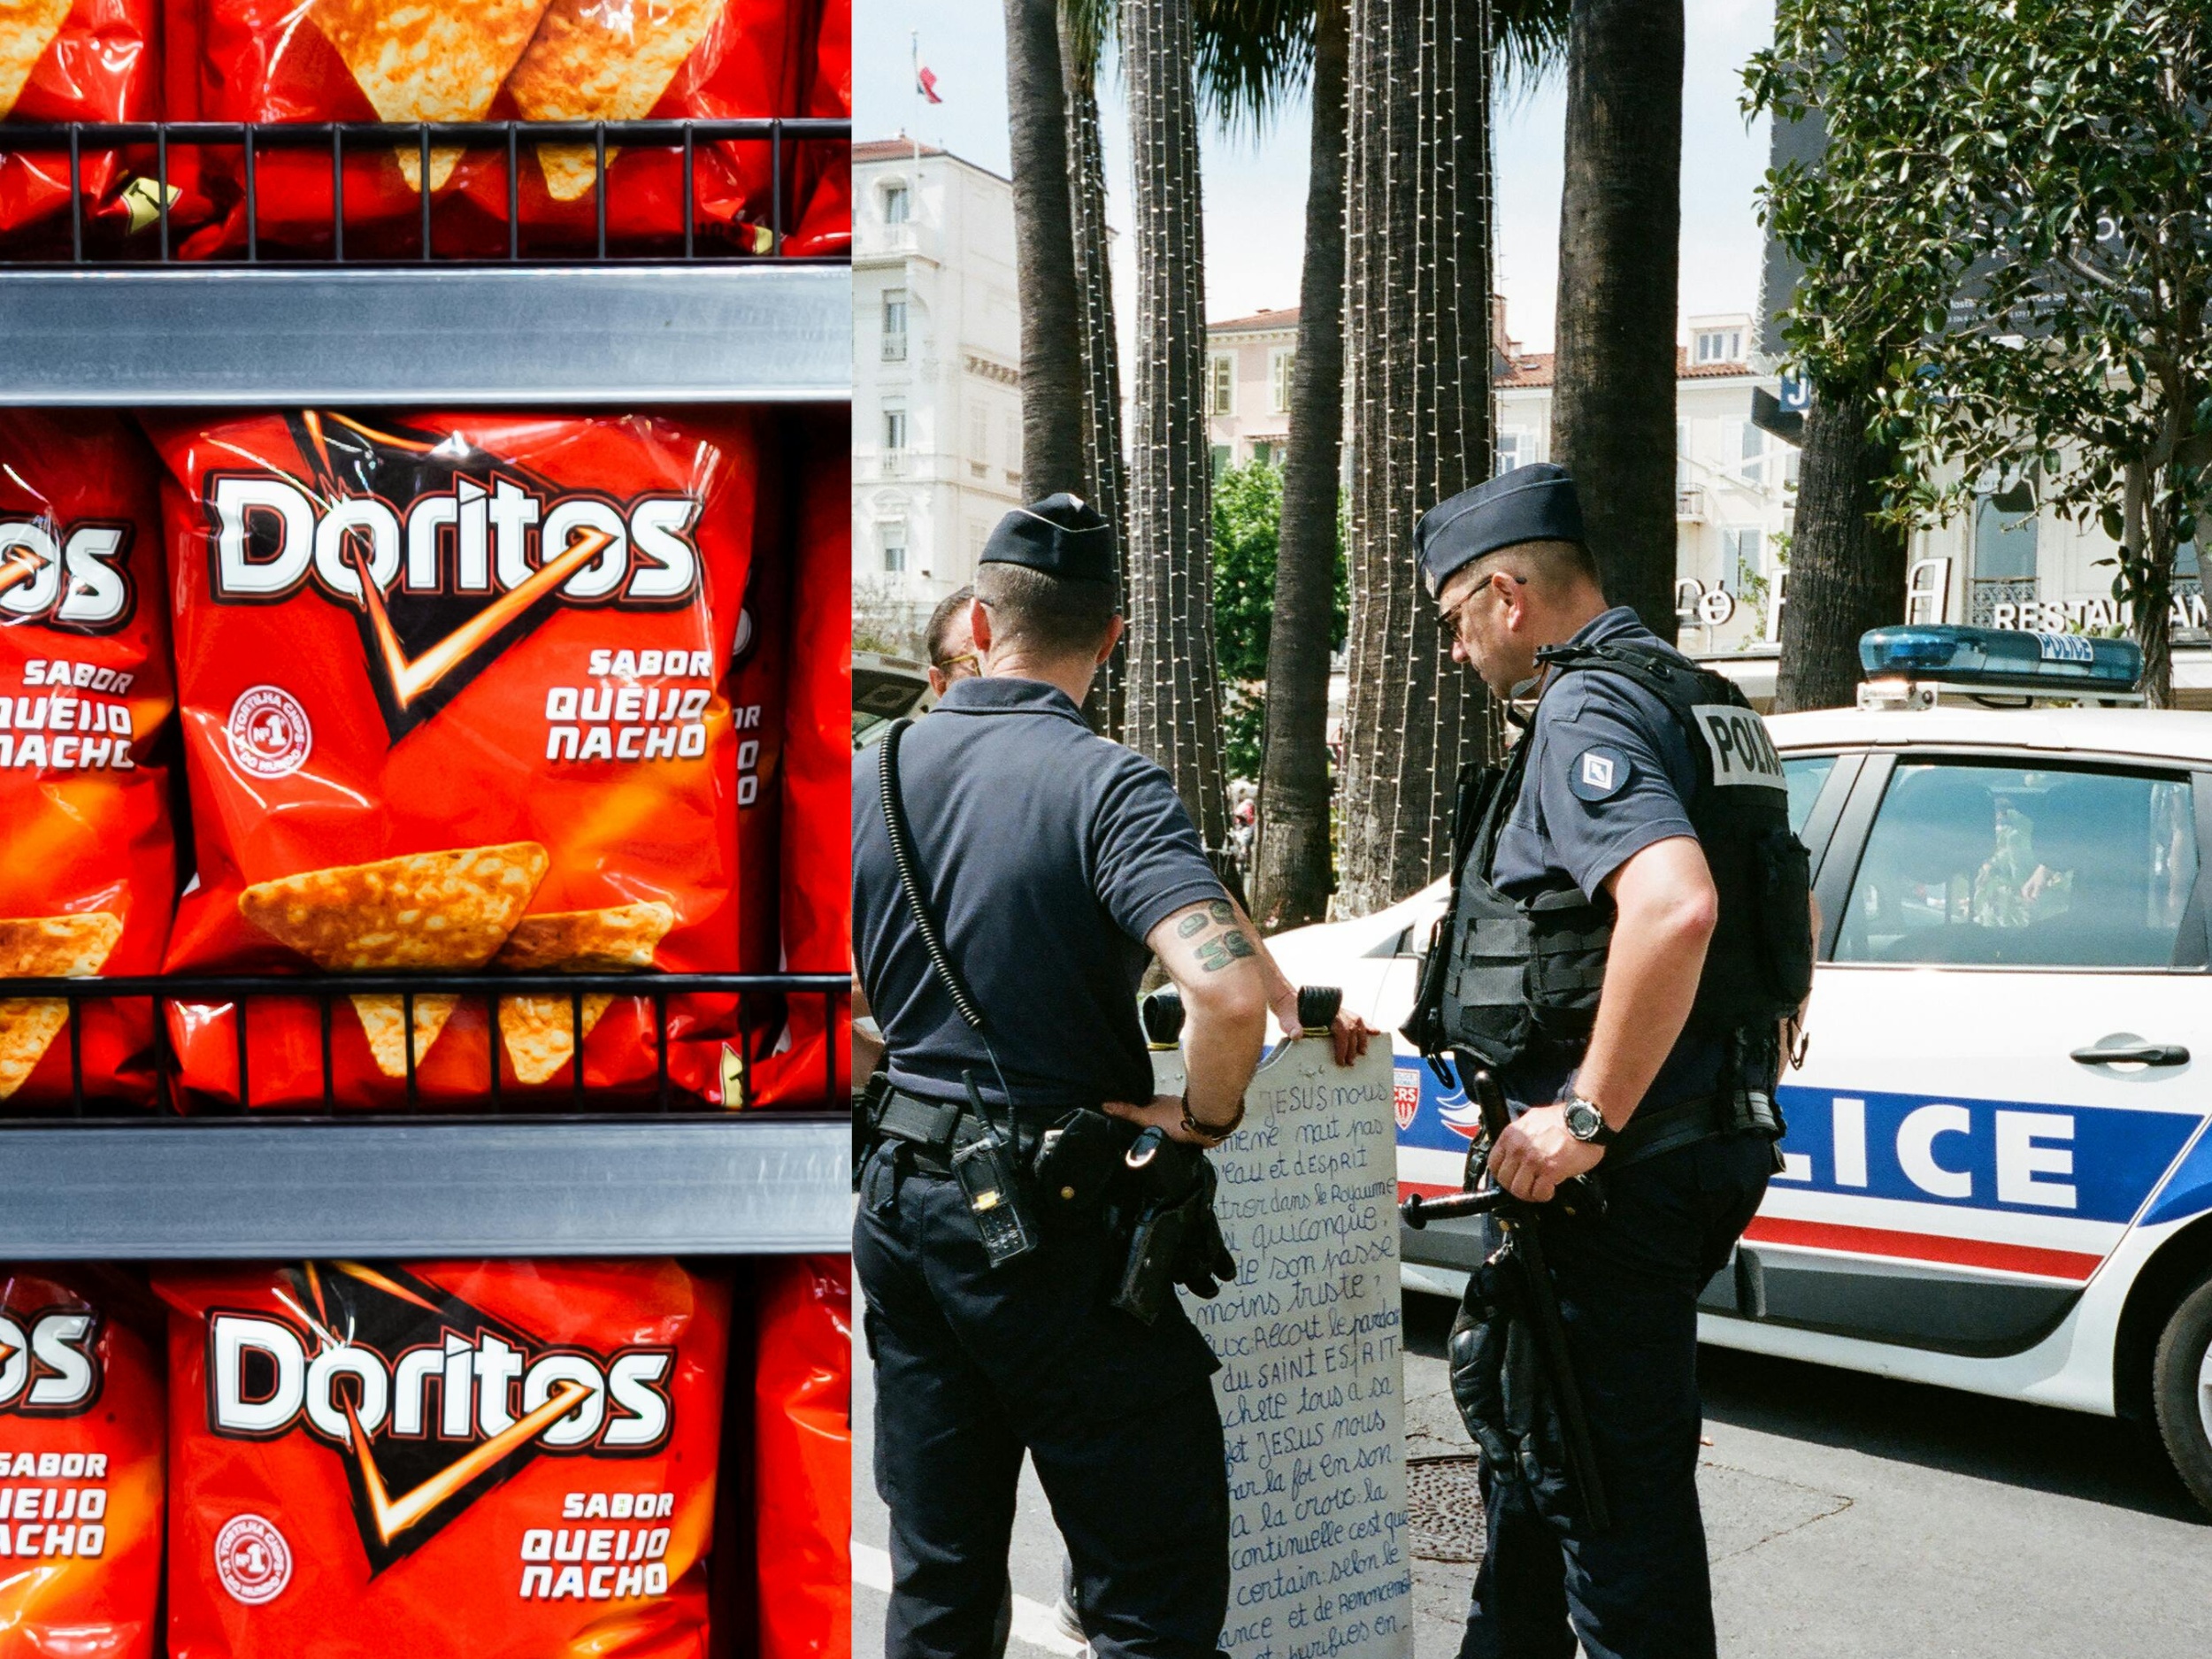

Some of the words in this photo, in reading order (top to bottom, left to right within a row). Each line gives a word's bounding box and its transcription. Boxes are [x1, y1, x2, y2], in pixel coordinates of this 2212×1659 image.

[215, 478, 702, 603] Doritos
[588, 649, 712, 679] SABOR
[2038, 633, 2092, 659] POLICE
[23, 659, 134, 694] SABOR
[545, 687, 711, 721] QUEIJO
[546, 724, 707, 760] NACHO
[1259, 1086, 1327, 1128] JESUS
[215, 1317, 669, 1448] Doritos
[562, 1493, 674, 1518] SABOR
[520, 1527, 672, 1563] QUEIJO
[519, 1562, 669, 1599] NACHO
